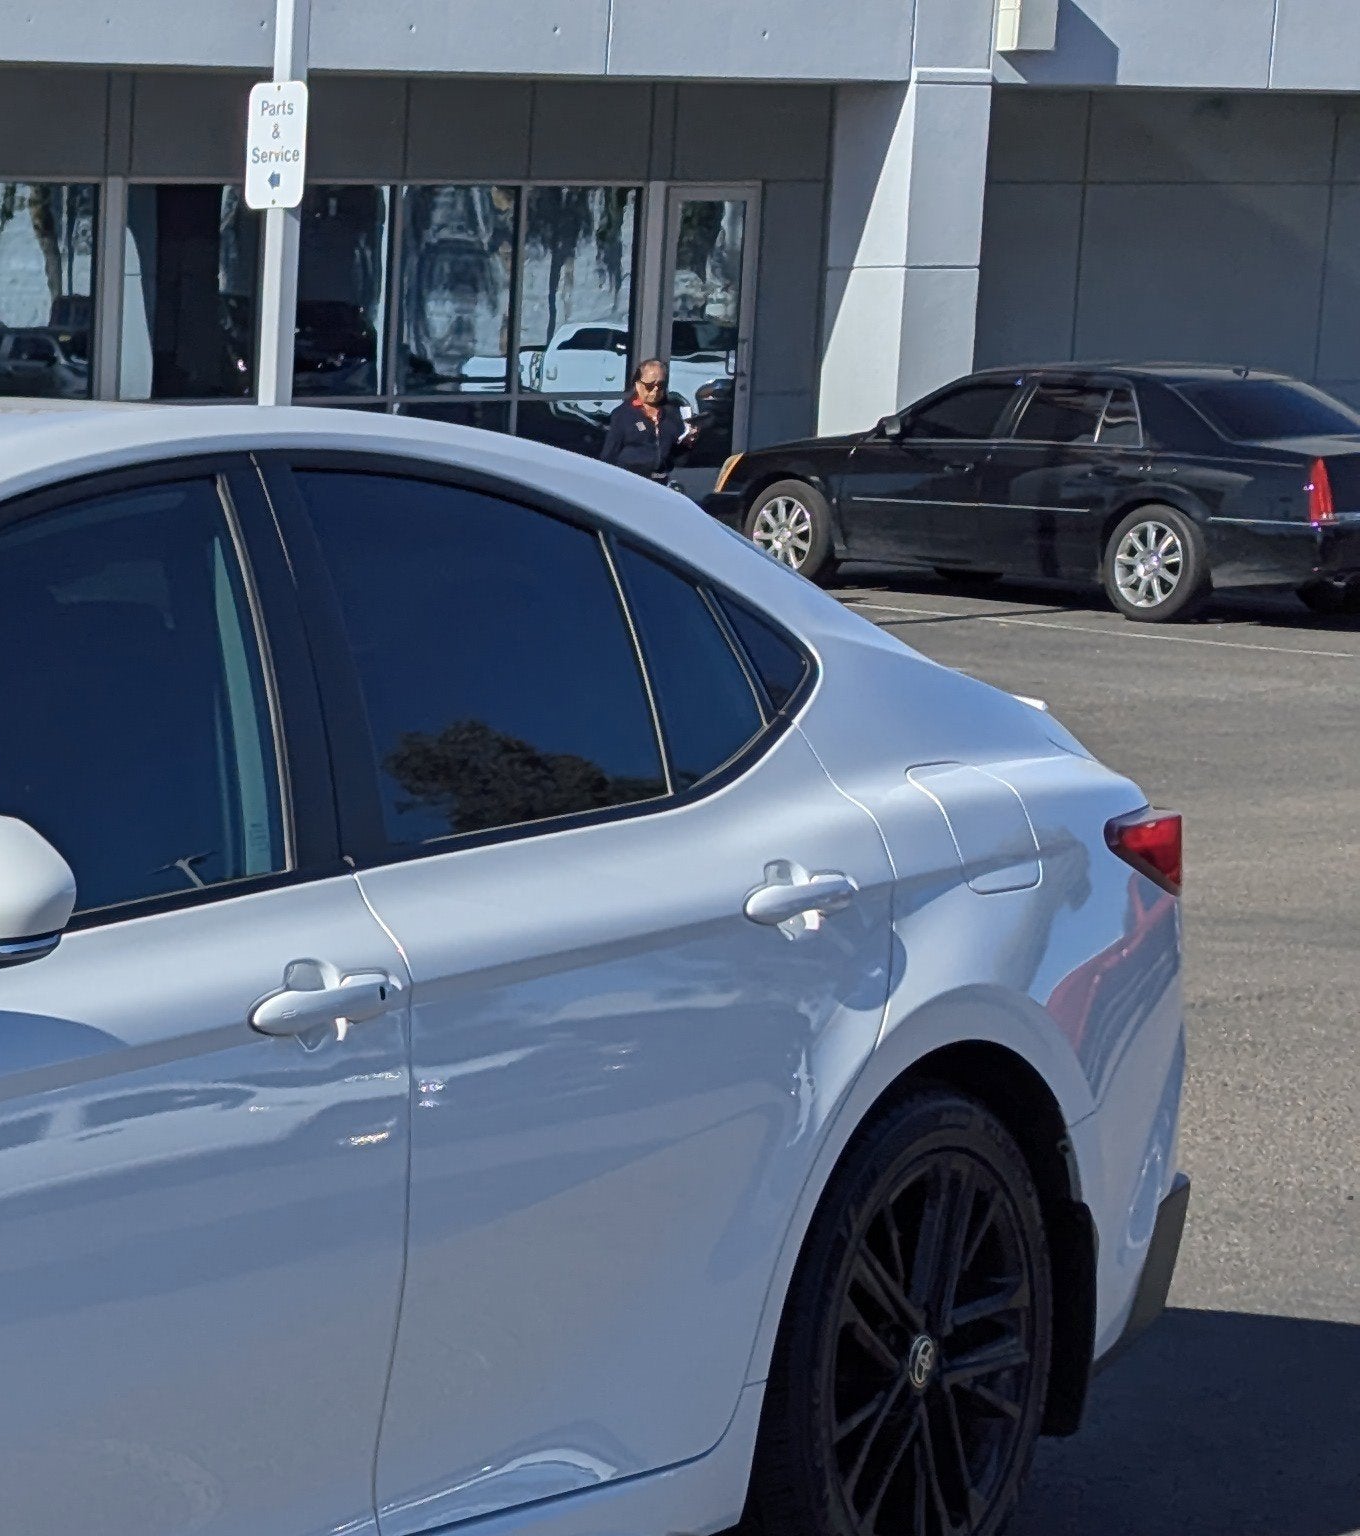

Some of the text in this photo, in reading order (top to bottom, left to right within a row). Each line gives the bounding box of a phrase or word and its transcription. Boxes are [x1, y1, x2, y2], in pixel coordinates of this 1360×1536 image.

[261, 100, 294, 116] Parts
[271, 123, 281, 139] &
[251, 145, 300, 164] Service
